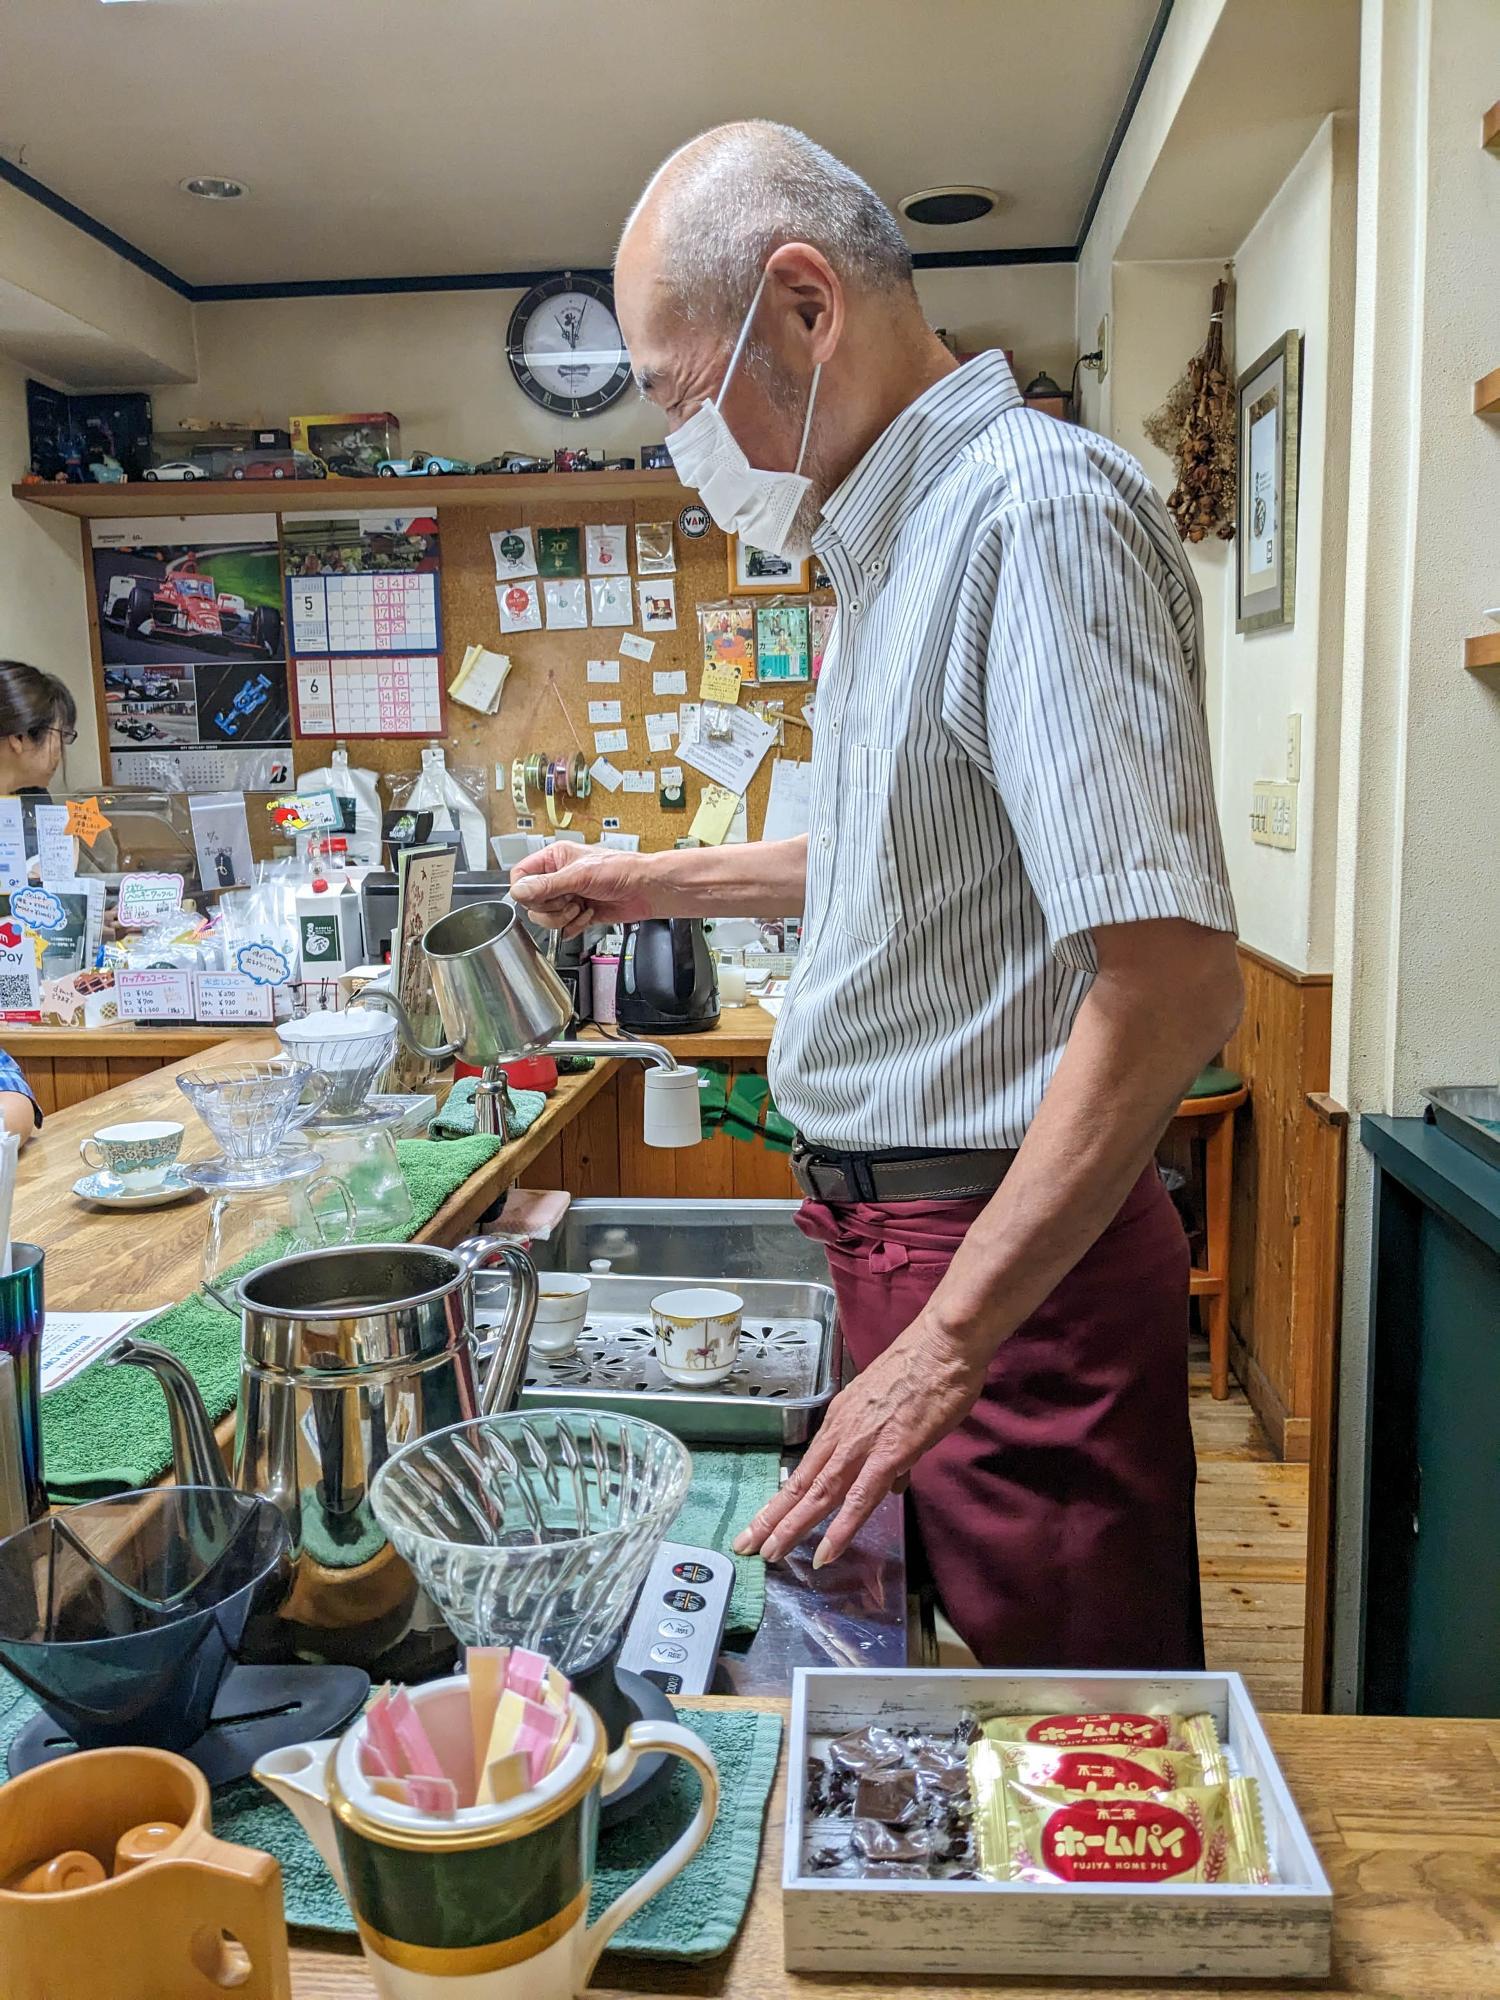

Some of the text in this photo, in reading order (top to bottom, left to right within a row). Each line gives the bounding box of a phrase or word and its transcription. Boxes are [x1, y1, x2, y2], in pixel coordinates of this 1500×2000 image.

[685, 516, 705, 526] VAN
[376, 578, 415, 589] 3 4 5
[304, 592, 402, 611] 5 10 11
[376, 607, 387, 618] 17
[377, 622, 405, 633] 24 25
[378, 637, 388, 648] 31
[310, 675, 406, 693] 6 7 8
[382, 691, 407, 702] 14 15
[382, 704, 408, 717] 21 22
[0, 949, 23, 965] Pay
[1038, 1721, 1154, 1742] ホームパイ
[1077, 1764, 1115, 1777] 不二家
[1096, 1807, 1136, 1820] 不二家
[1053, 1823, 1185, 1858] ホームパイ
[1073, 1862, 1168, 1871] FUJIYA HOME PIE
